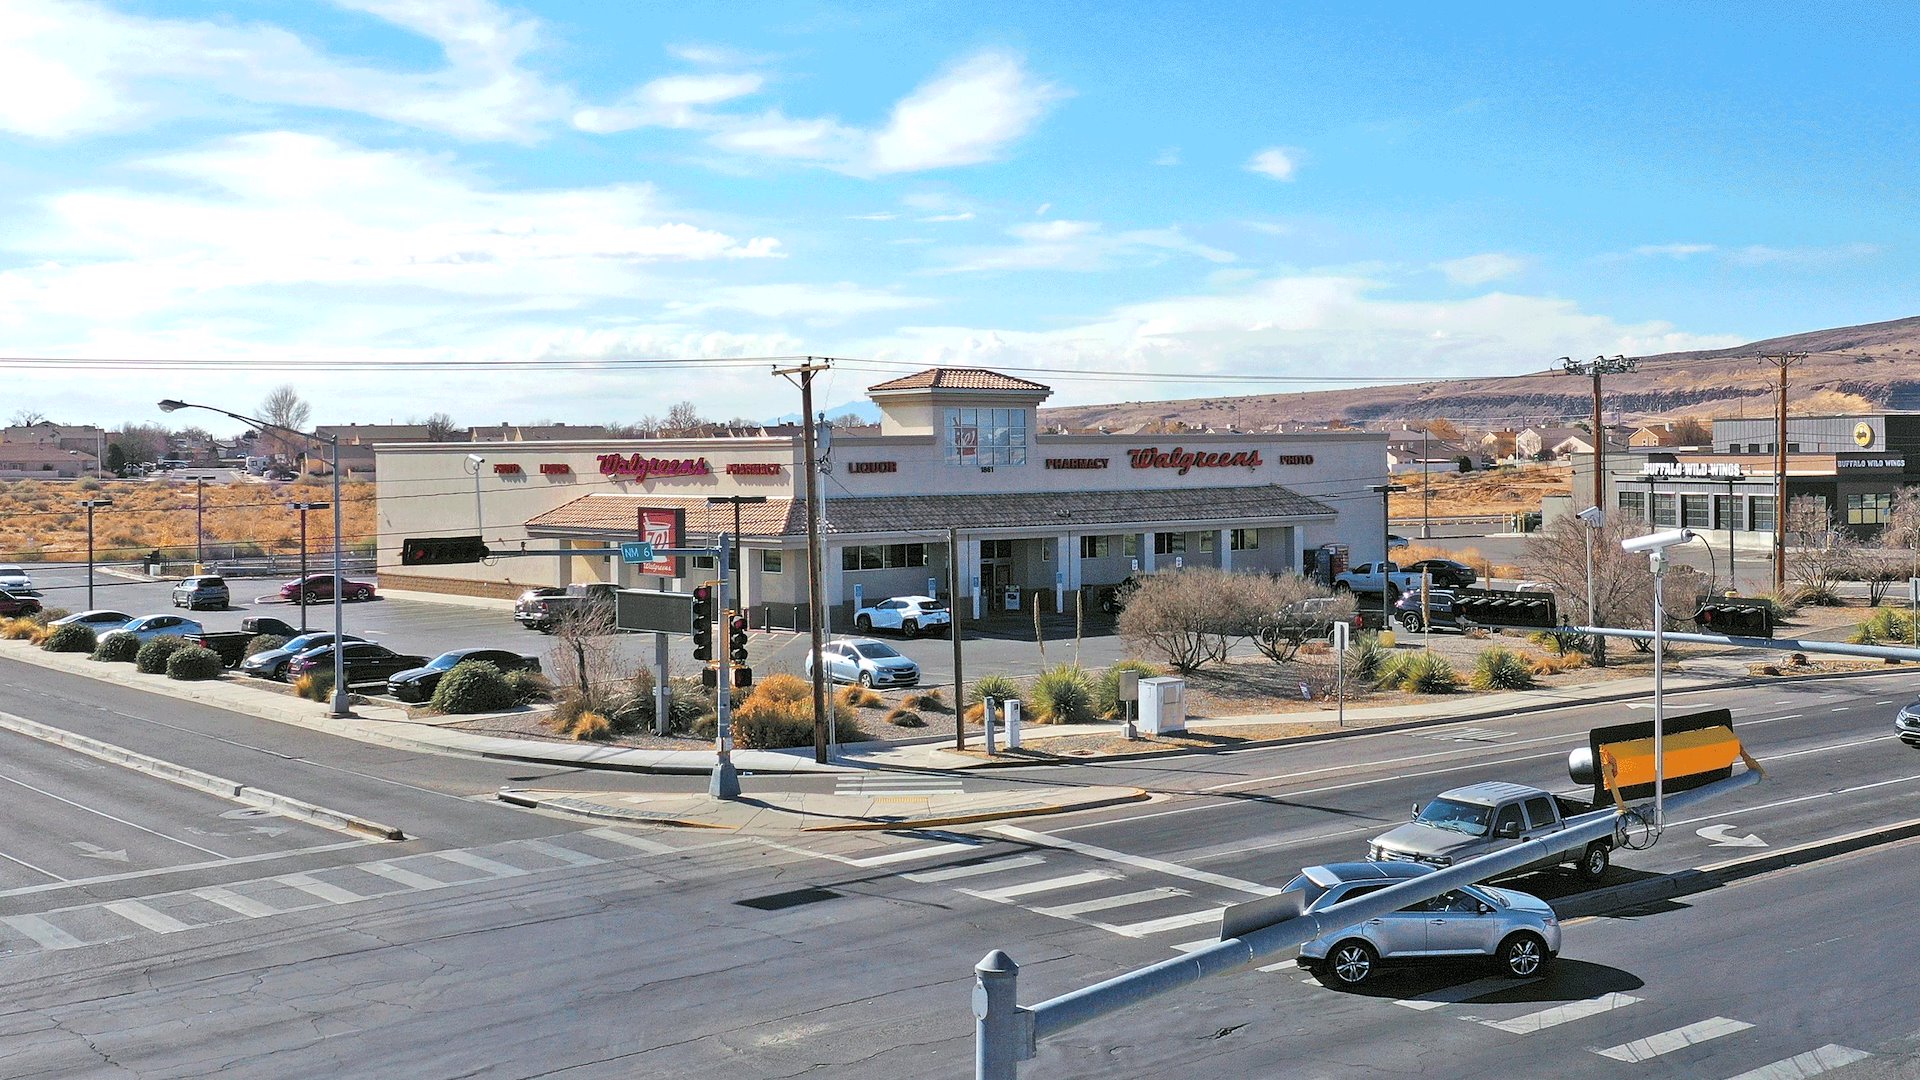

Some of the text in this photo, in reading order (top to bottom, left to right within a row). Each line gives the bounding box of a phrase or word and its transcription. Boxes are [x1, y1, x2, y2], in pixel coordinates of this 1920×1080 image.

[1045, 458, 1109, 469] PHARMACY
[1127, 447, 1263, 475] Walgreens
[1280, 455, 1314, 465] PHOTO
[1837, 460, 1866, 468] BUFFALO
[1867, 460, 1884, 468] WILD
[597, 453, 709, 484] Walgreens
[848, 461, 897, 473] LIQUOR
[1643, 462, 1741, 477] BUFFALO WILD WINGS
[624, 547, 651, 558] NM 6
[643, 562, 672, 572] Walgreens
